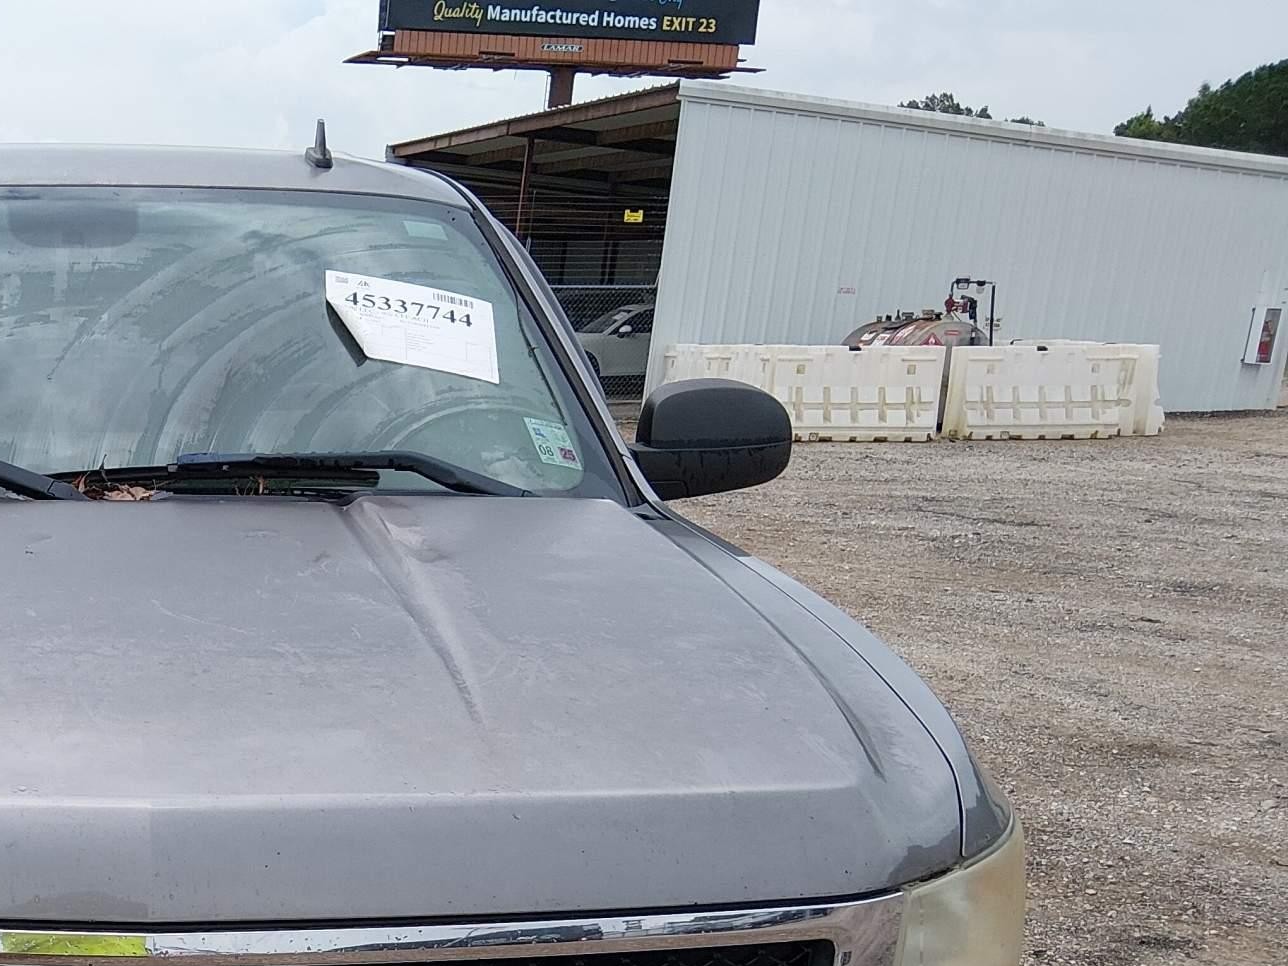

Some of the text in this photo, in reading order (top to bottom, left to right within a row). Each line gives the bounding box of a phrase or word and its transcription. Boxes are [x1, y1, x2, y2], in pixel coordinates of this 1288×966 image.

[433, 0, 717, 33] Quality Manufactured Homes EXIT 23
[344, 291, 473, 328] 45337744
[538, 444, 577, 461] 08 25
